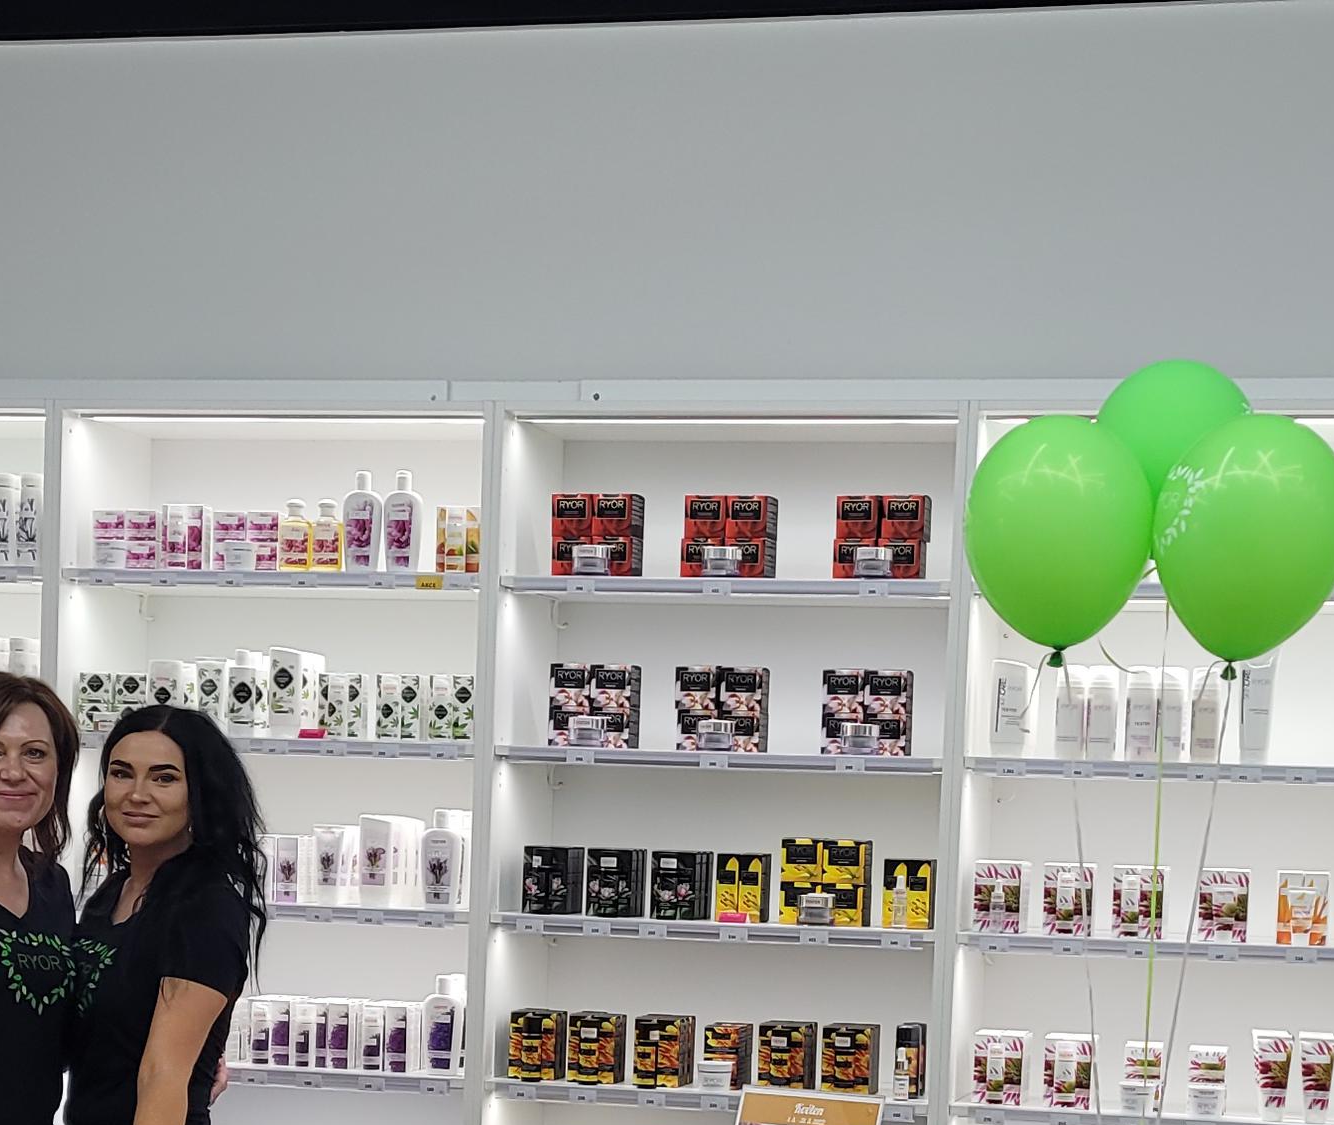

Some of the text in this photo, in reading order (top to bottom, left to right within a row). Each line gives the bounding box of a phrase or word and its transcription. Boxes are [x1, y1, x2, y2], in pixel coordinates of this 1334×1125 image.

[559, 500, 584, 509] RYOR
[599, 500, 624, 509] RYOR
[692, 502, 718, 511] RYOR
[734, 502, 759, 511] RYOR
[844, 502, 869, 511] RYOR
[890, 502, 916, 511] RYOR
[557, 670, 582, 680] RYOR
[598, 671, 623, 680] RYOR
[683, 673, 708, 682] RYOR
[728, 674, 754, 684] RYOR
[830, 676, 856, 685] RYOR
[872, 677, 899, 686] RYOR
[17, 953, 63, 971] RYOR
